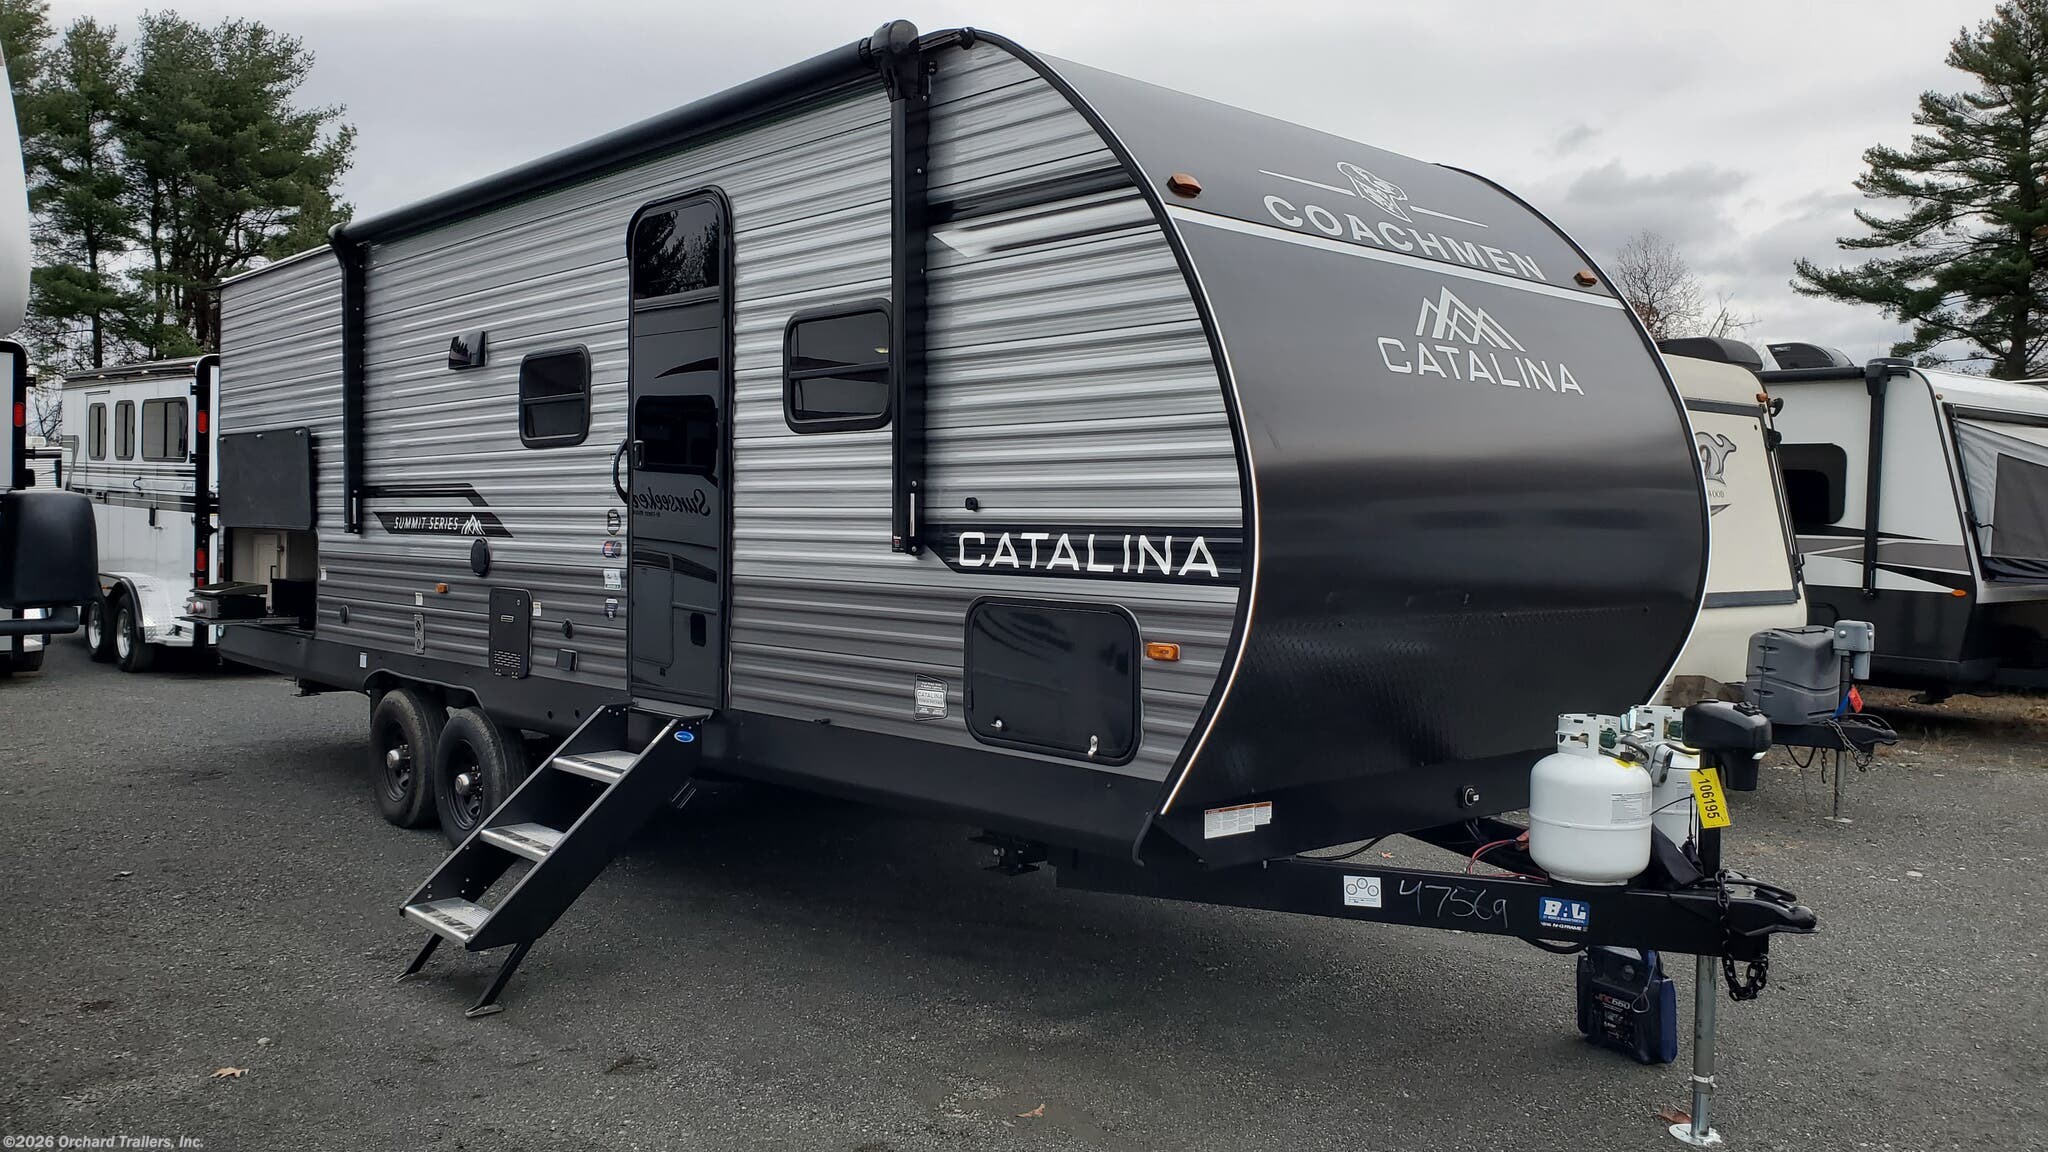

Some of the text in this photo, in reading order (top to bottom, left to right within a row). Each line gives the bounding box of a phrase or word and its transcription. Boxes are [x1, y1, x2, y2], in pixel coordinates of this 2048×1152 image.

[1264, 195, 1546, 281] COACHMEN
[1377, 337, 1585, 395] CATALINA
[394, 516, 459, 530] SUMMIT SERIES
[958, 531, 1219, 577] CATALINA
[1698, 778, 1721, 819] 106195
